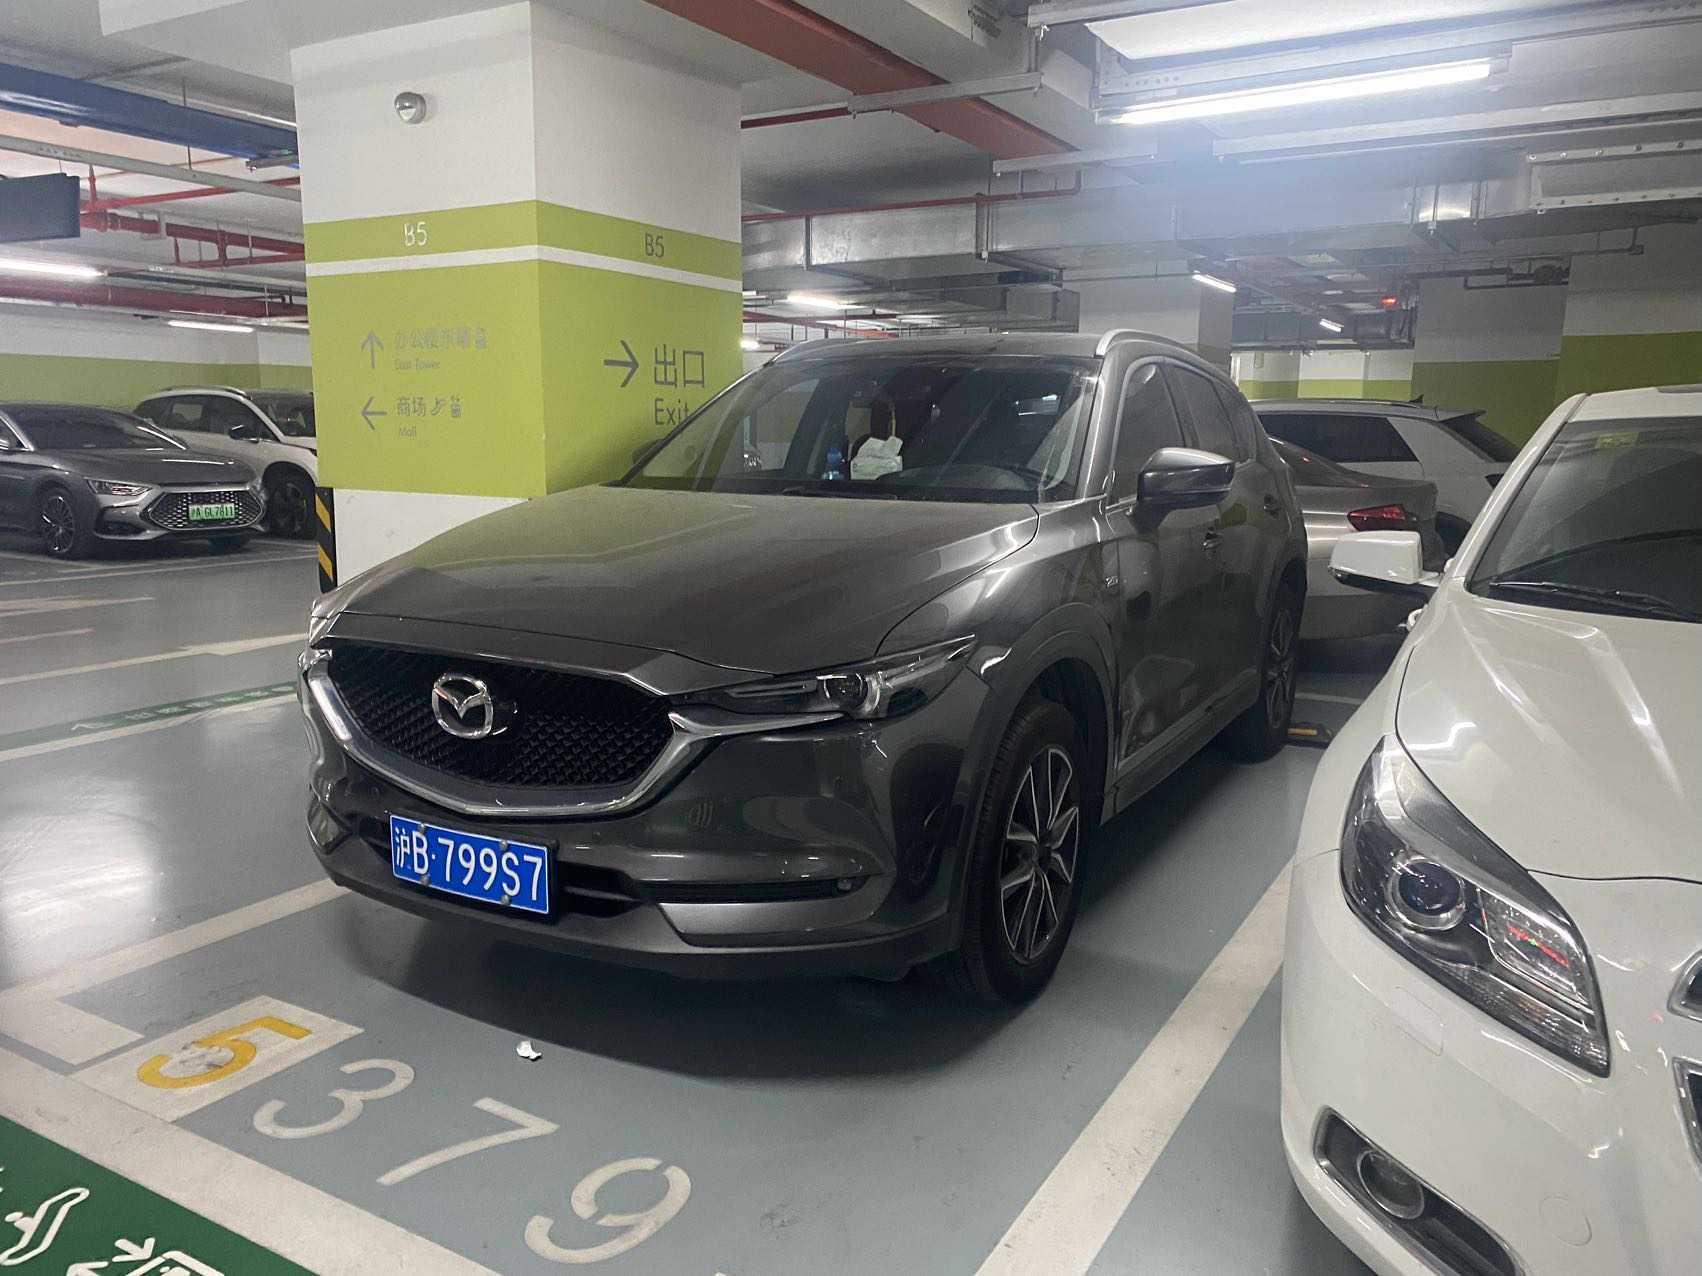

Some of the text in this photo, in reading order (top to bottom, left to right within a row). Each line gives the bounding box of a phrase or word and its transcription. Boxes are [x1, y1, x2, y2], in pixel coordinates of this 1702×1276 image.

[403, 221, 428, 246] B5
[645, 233, 664, 258] B5
[654, 343, 705, 388] 出口
[397, 395, 427, 418] 商场
[654, 398, 689, 426] Exit
